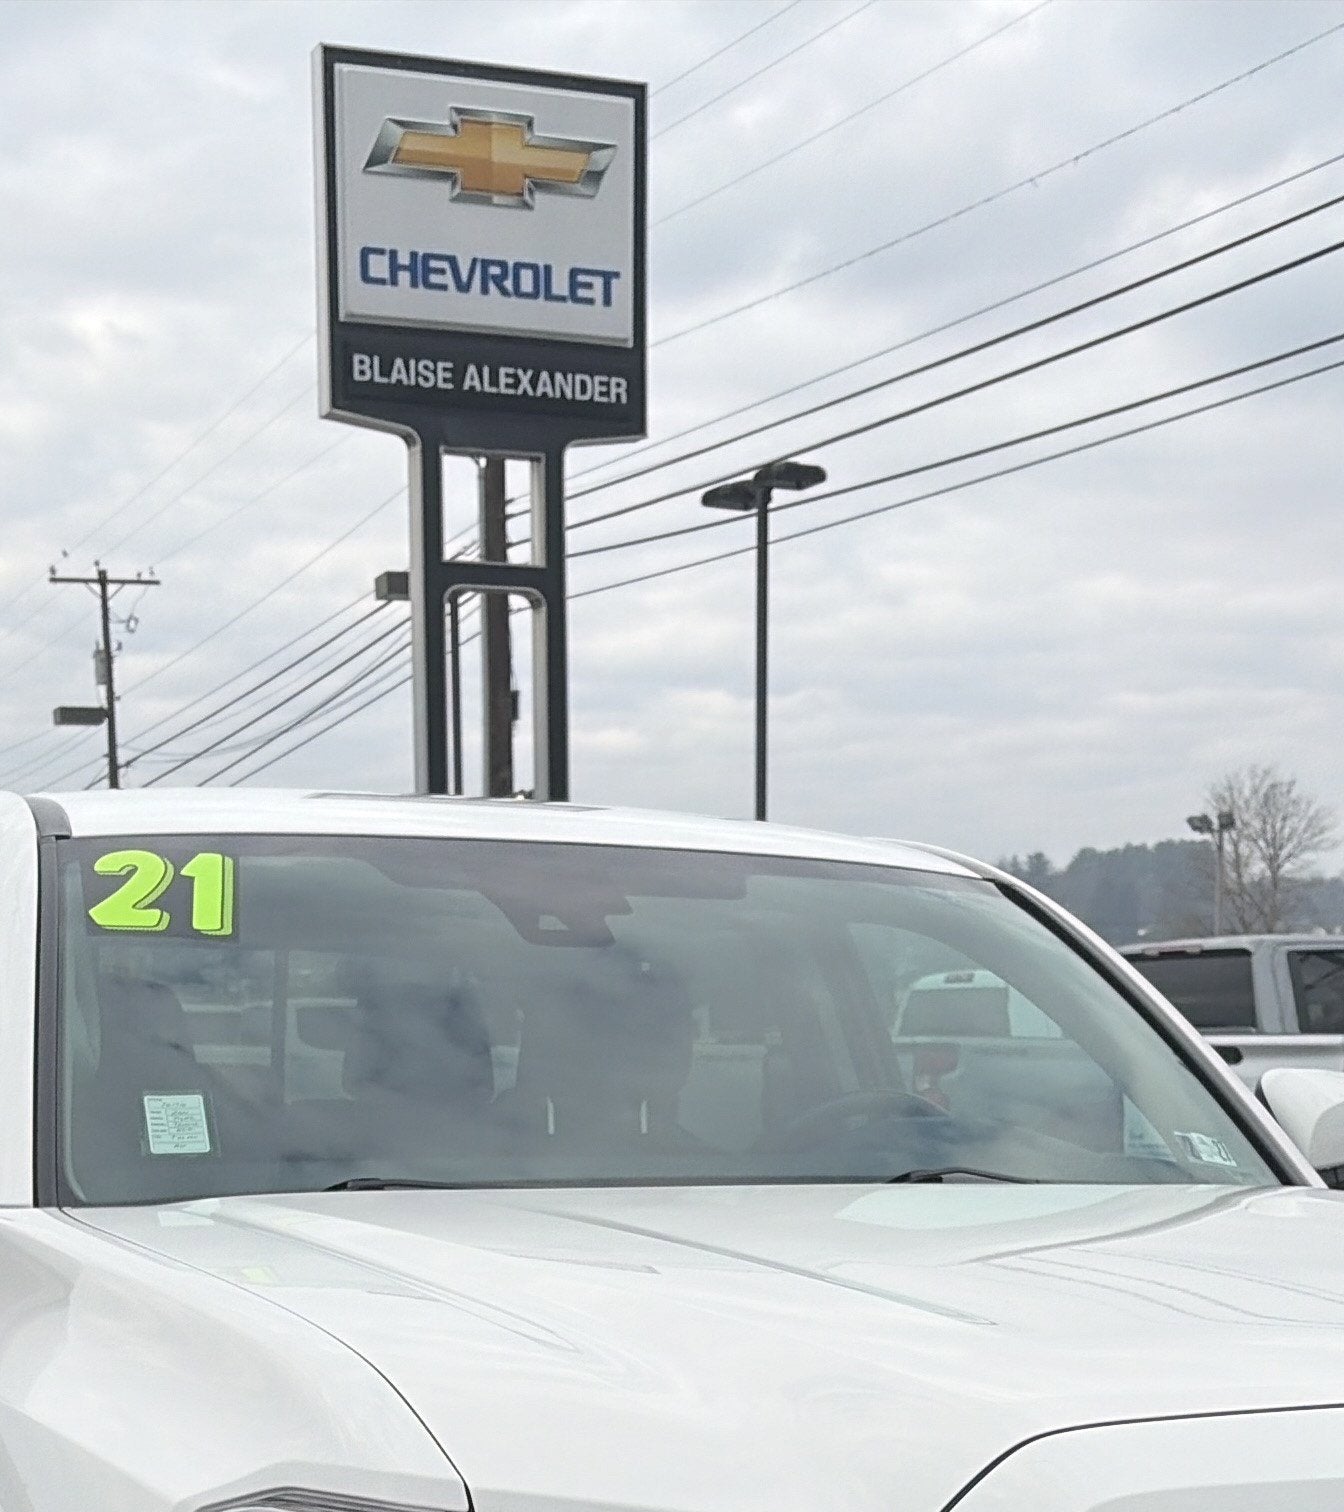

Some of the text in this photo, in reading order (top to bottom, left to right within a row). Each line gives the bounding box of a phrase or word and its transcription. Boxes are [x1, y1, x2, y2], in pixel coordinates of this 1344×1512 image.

[360, 246, 621, 308] CHEVROLET
[352, 352, 628, 404] BLAISE ALEXANDER
[88, 849, 234, 937] 21
